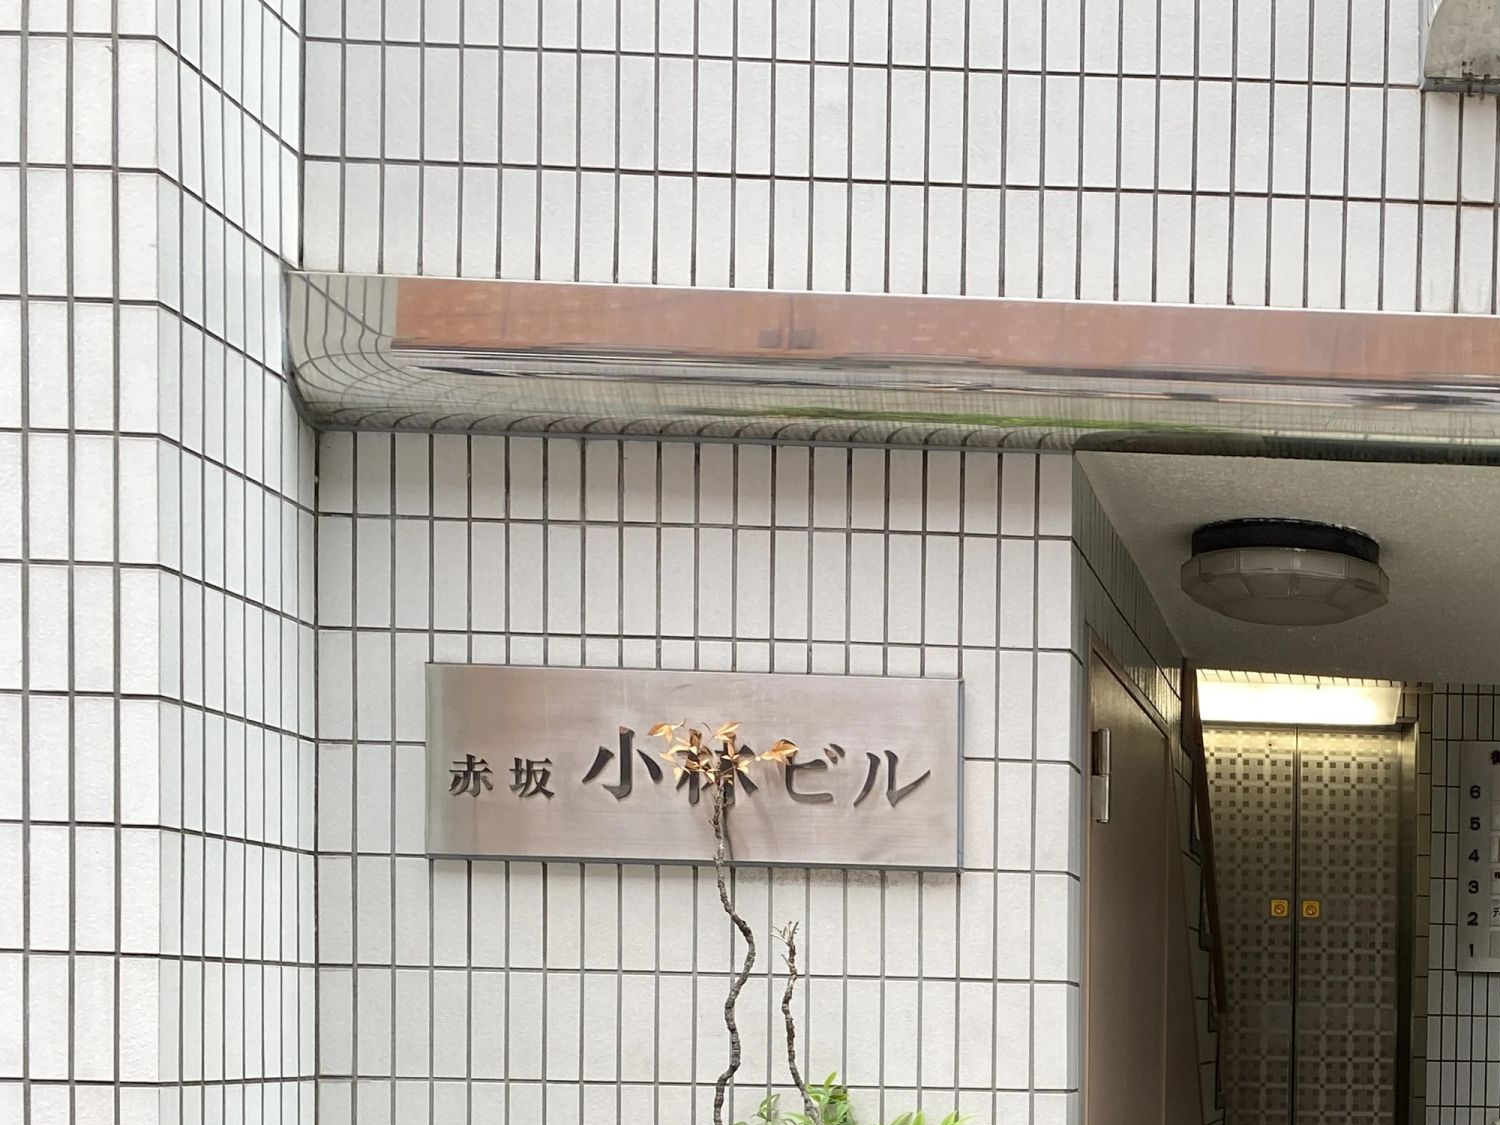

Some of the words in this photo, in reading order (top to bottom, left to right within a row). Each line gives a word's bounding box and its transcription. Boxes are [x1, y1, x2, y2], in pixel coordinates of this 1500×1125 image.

[1470, 785, 1481, 799] 6
[1470, 817, 1480, 831] 5
[1468, 849, 1479, 862] 4
[1468, 880, 1479, 894] 3
[1467, 912, 1479, 926] 2
[1469, 943, 1475, 957] 1
